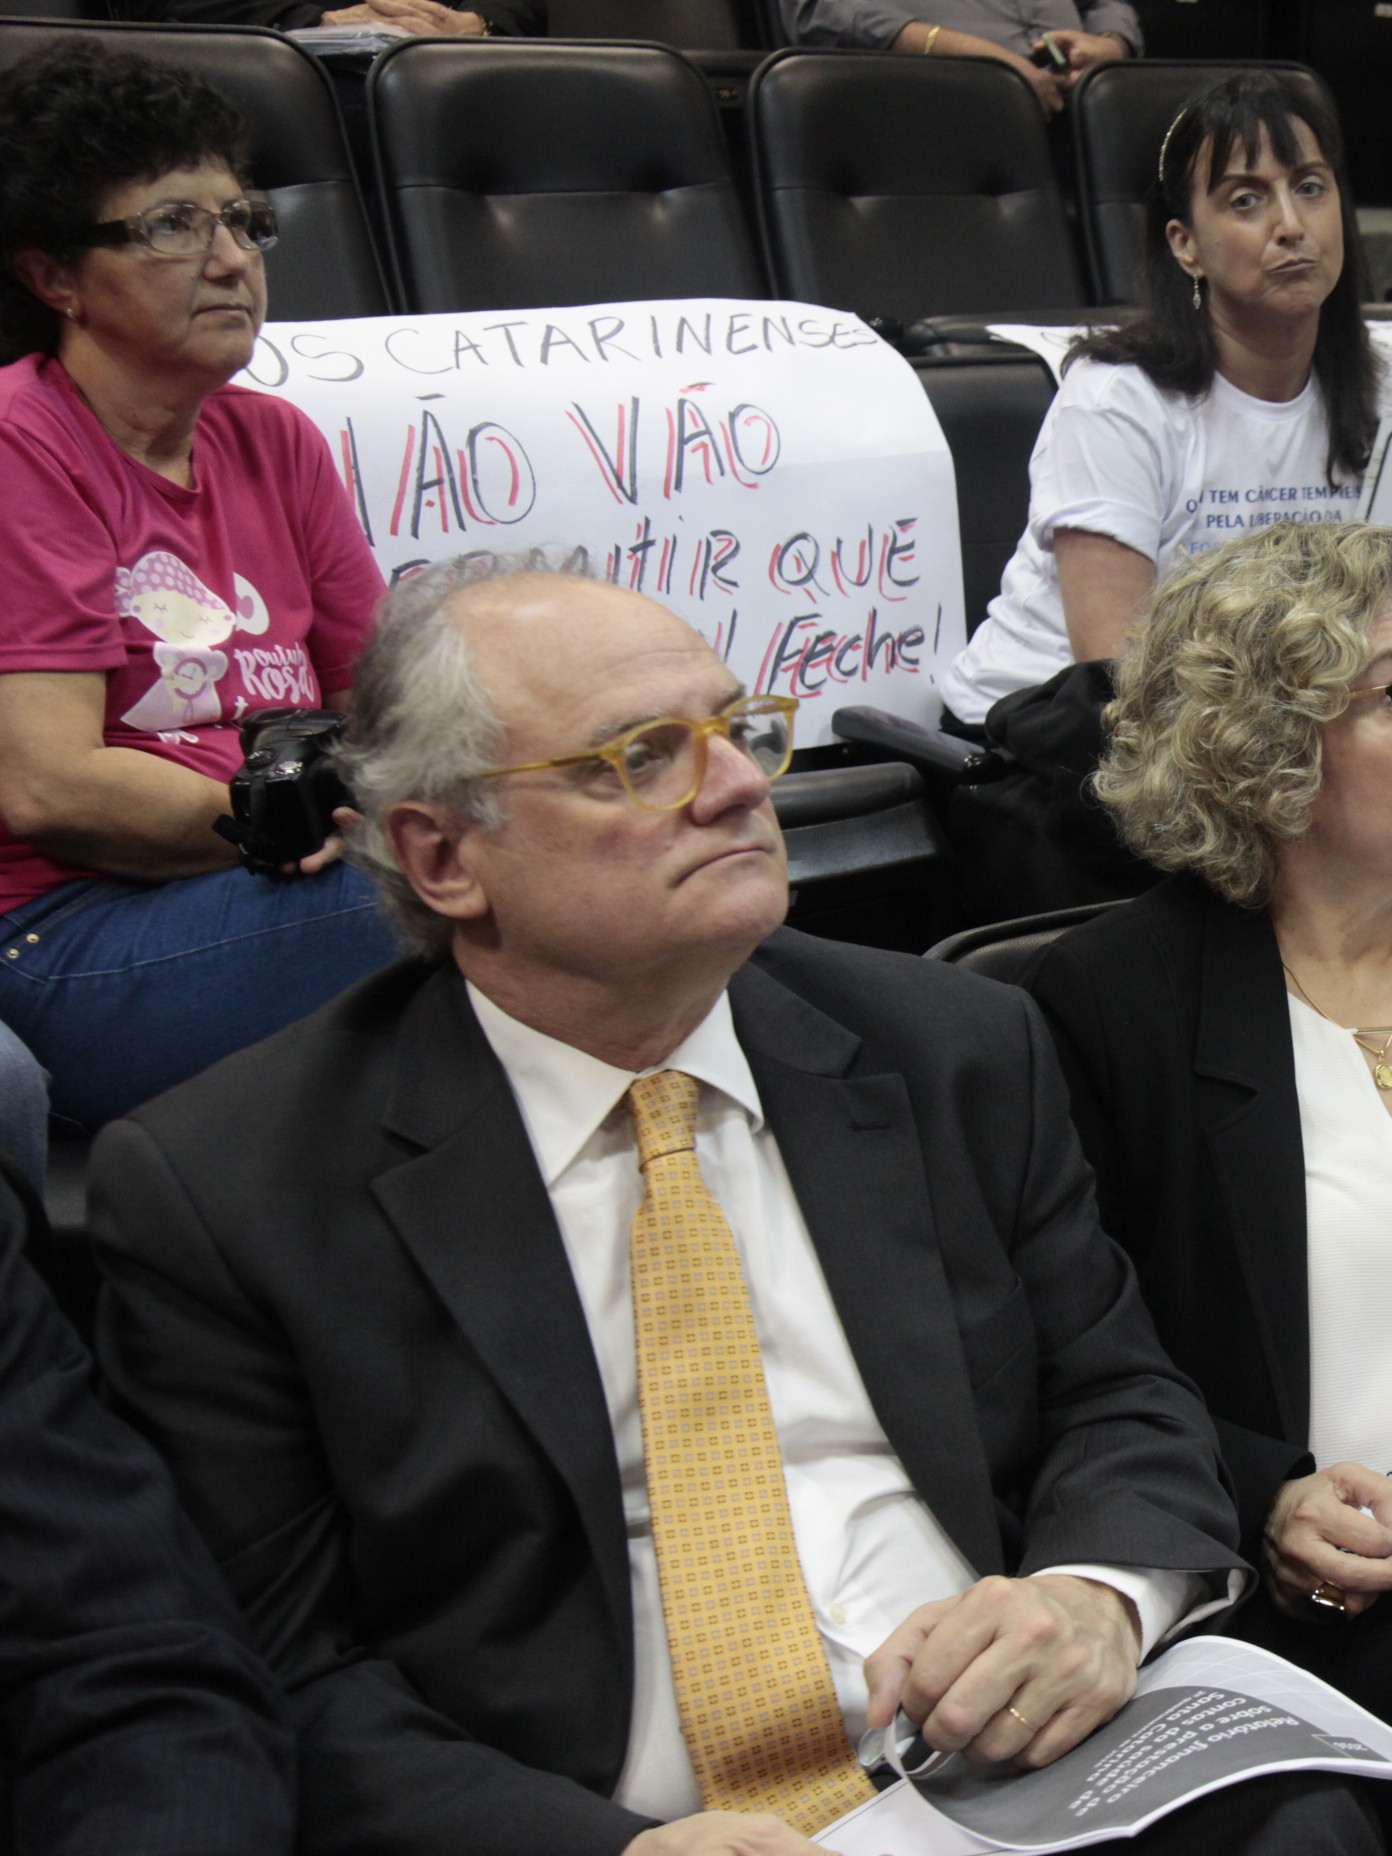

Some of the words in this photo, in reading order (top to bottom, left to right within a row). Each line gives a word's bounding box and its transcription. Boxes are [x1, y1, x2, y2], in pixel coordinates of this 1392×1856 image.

[386, 313, 878, 374] CATARINENSES
[565, 382, 780, 505] VÃO
[1209, 489, 1238, 503] TEM
[1206, 514, 1244, 529] PELA
[768, 517, 920, 603] QUE
[1166, 1691, 1225, 1721] Santa
[1182, 1697, 1247, 1726] contas
[1216, 1705, 1272, 1724] sobre
[1153, 1726, 1181, 1744] da
[1199, 1722, 1215, 1733] a
[1207, 1716, 1300, 1744] Relatório
[1086, 1722, 1168, 1782] Catarina
[1094, 1744, 1153, 1786] saúde
[1099, 1730, 1198, 1794] prestação
[1106, 1742, 1210, 1804] financeiro
[1068, 1790, 1094, 1810] de
[1074, 1796, 1101, 1817] de
